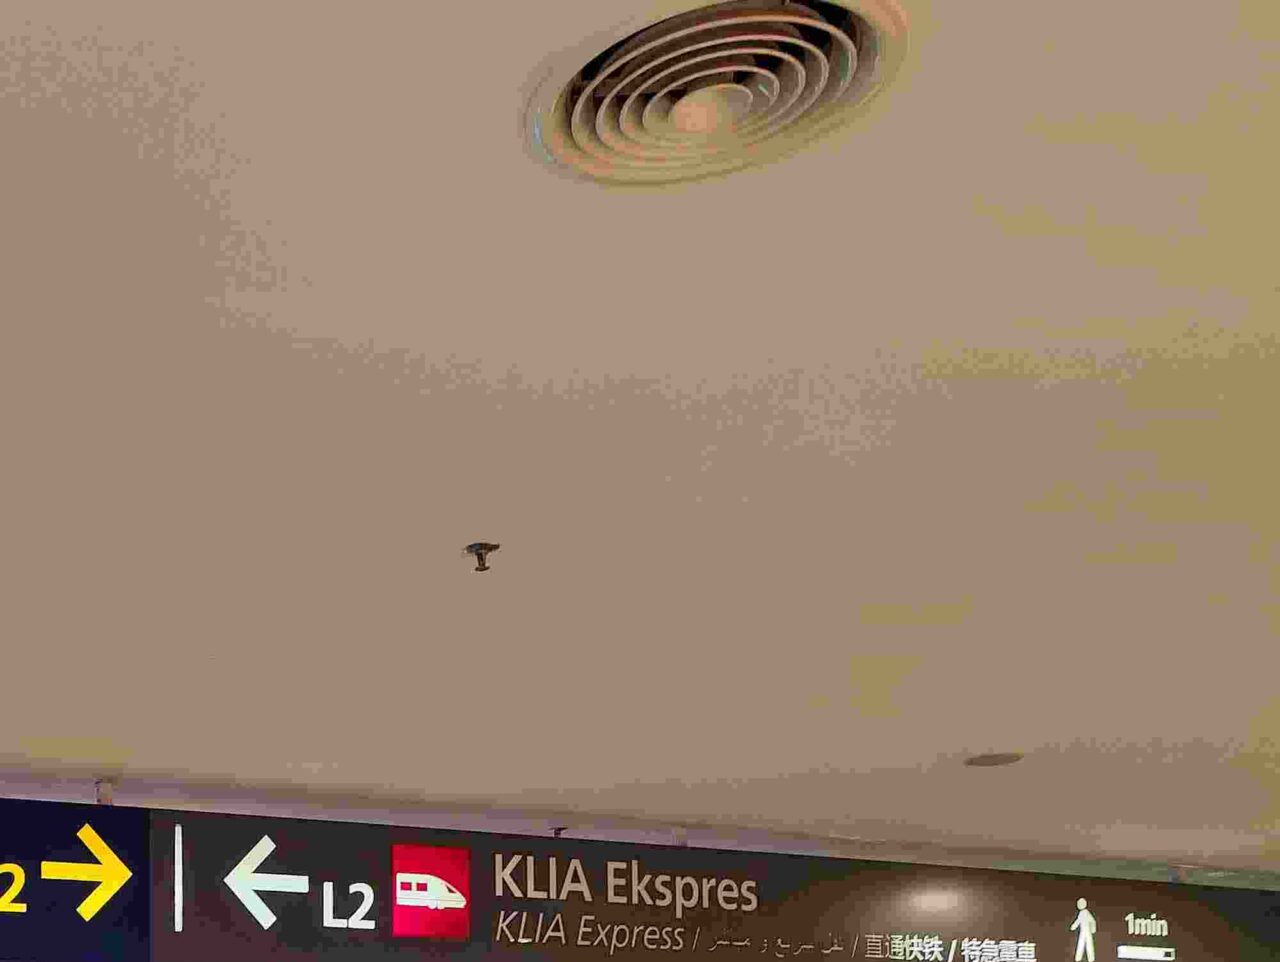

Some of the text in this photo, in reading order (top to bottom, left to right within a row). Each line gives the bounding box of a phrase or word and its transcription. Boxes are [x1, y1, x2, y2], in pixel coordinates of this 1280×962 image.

[322, 881, 377, 930] L2
[493, 852, 759, 918] KLIA Ekspres
[495, 910, 568, 944] KLIA
[576, 914, 685, 956] Express
[864, 932, 944, 962] 直通快铁
[1124, 911, 1169, 937] 1min
